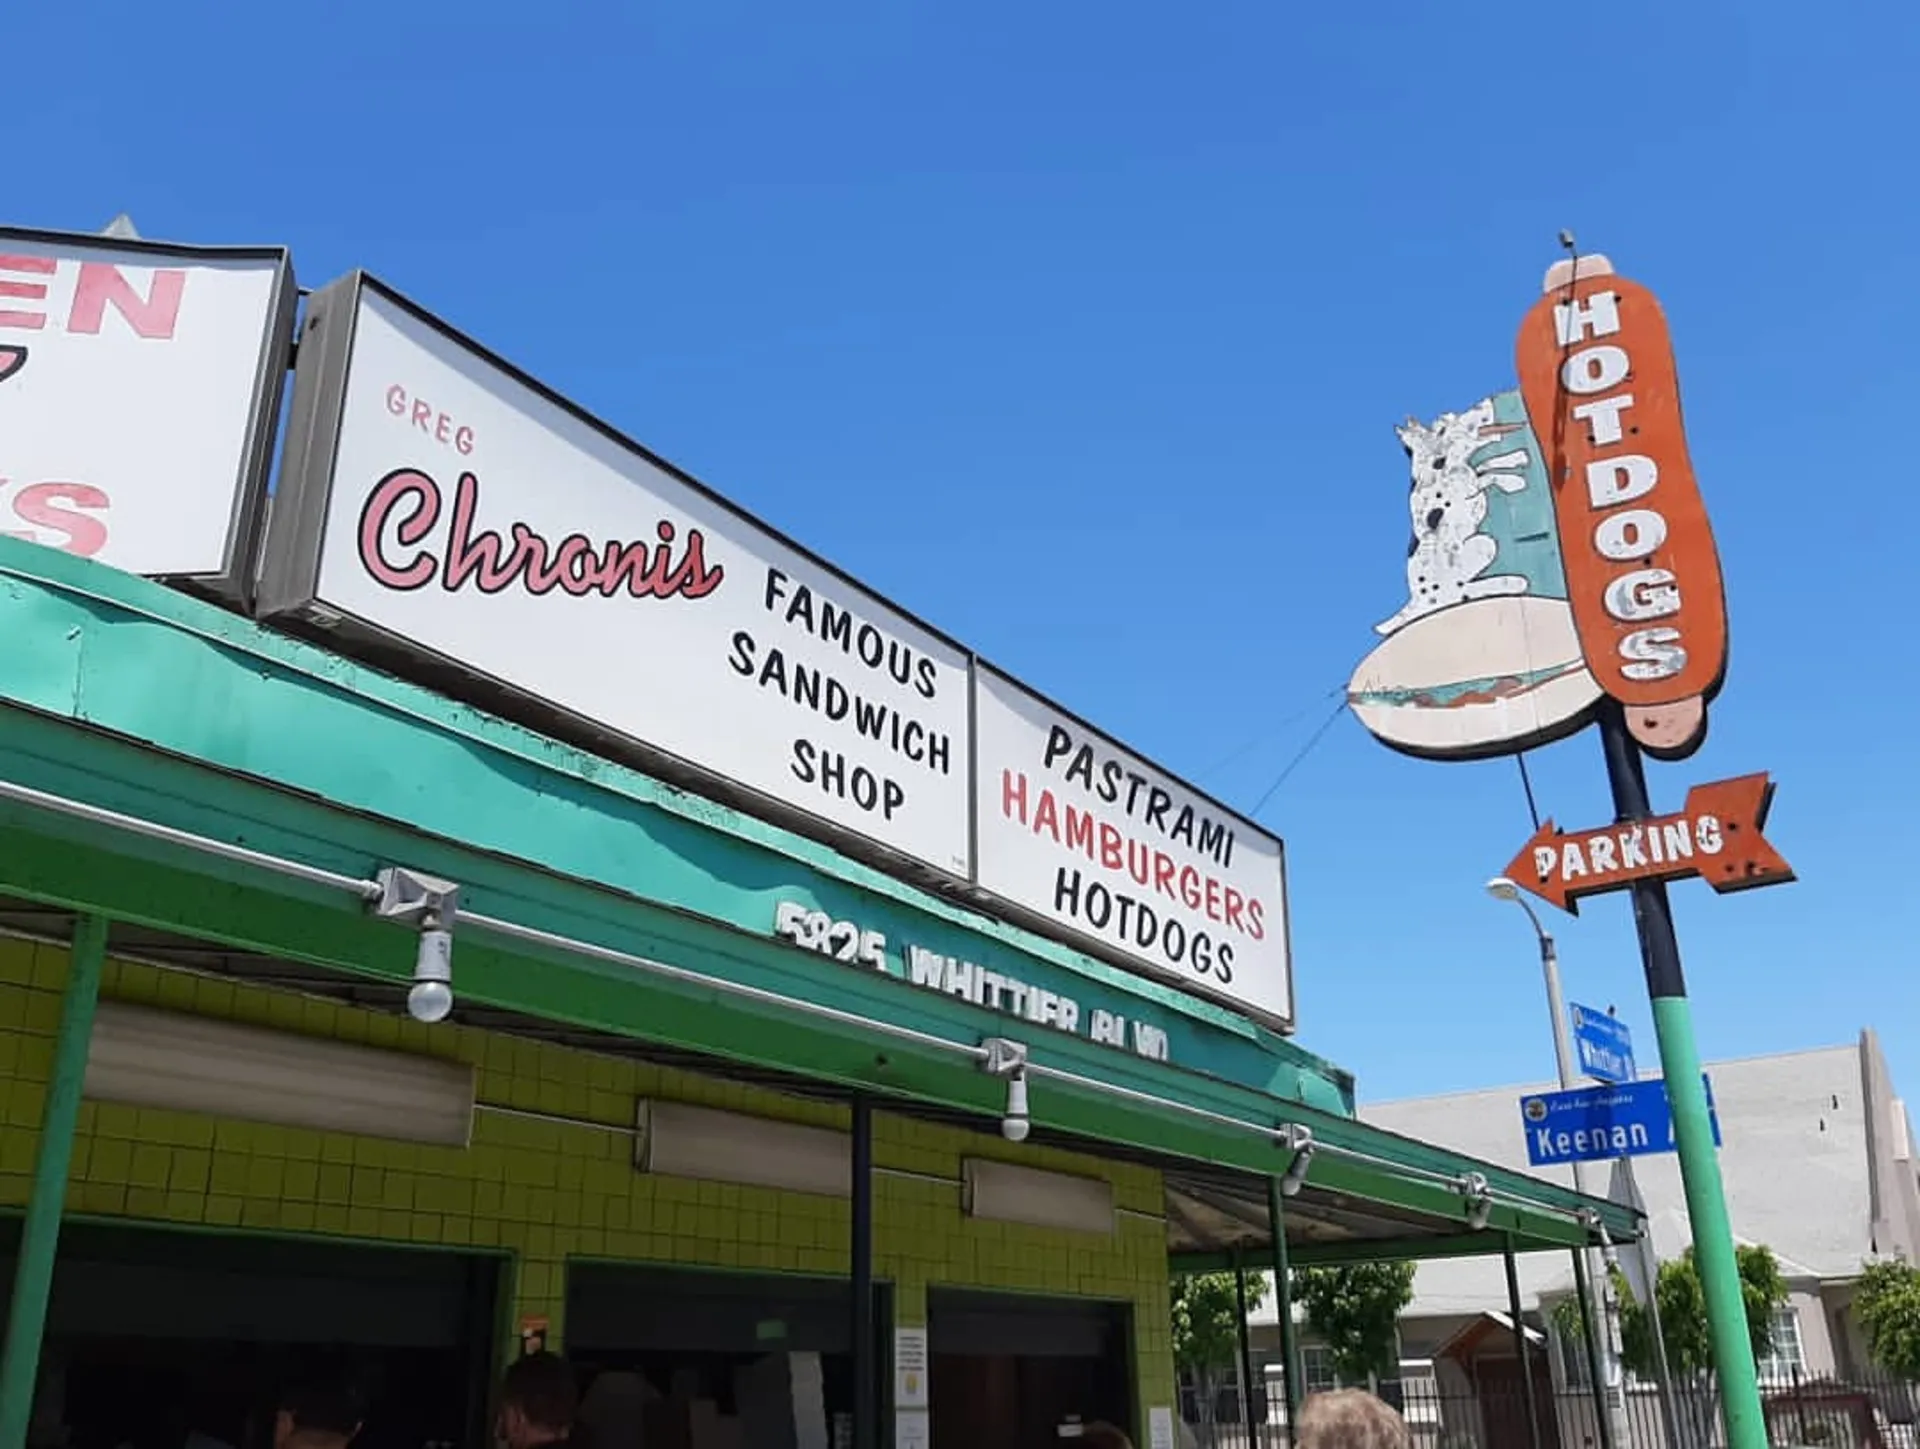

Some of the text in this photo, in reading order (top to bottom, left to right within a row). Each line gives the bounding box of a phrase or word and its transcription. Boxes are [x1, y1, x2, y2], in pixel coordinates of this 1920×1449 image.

[386, 384, 475, 455] GREG
[0, 479, 110, 557] S
[357, 467, 724, 600] Chronis
[764, 567, 937, 699] FAMOUS
[729, 631, 950, 775] SANDWICH
[790, 738, 905, 821] SHOP
[1044, 724, 1234, 868] PASTRAMI
[1002, 768, 1264, 940] HAMBURGERS
[1534, 815, 1724, 881] PARKING
[775, 900, 886, 971] 5825
[1055, 866, 1234, 984] HOTDOGS
[1537, 1122, 1649, 1158] Keenan
